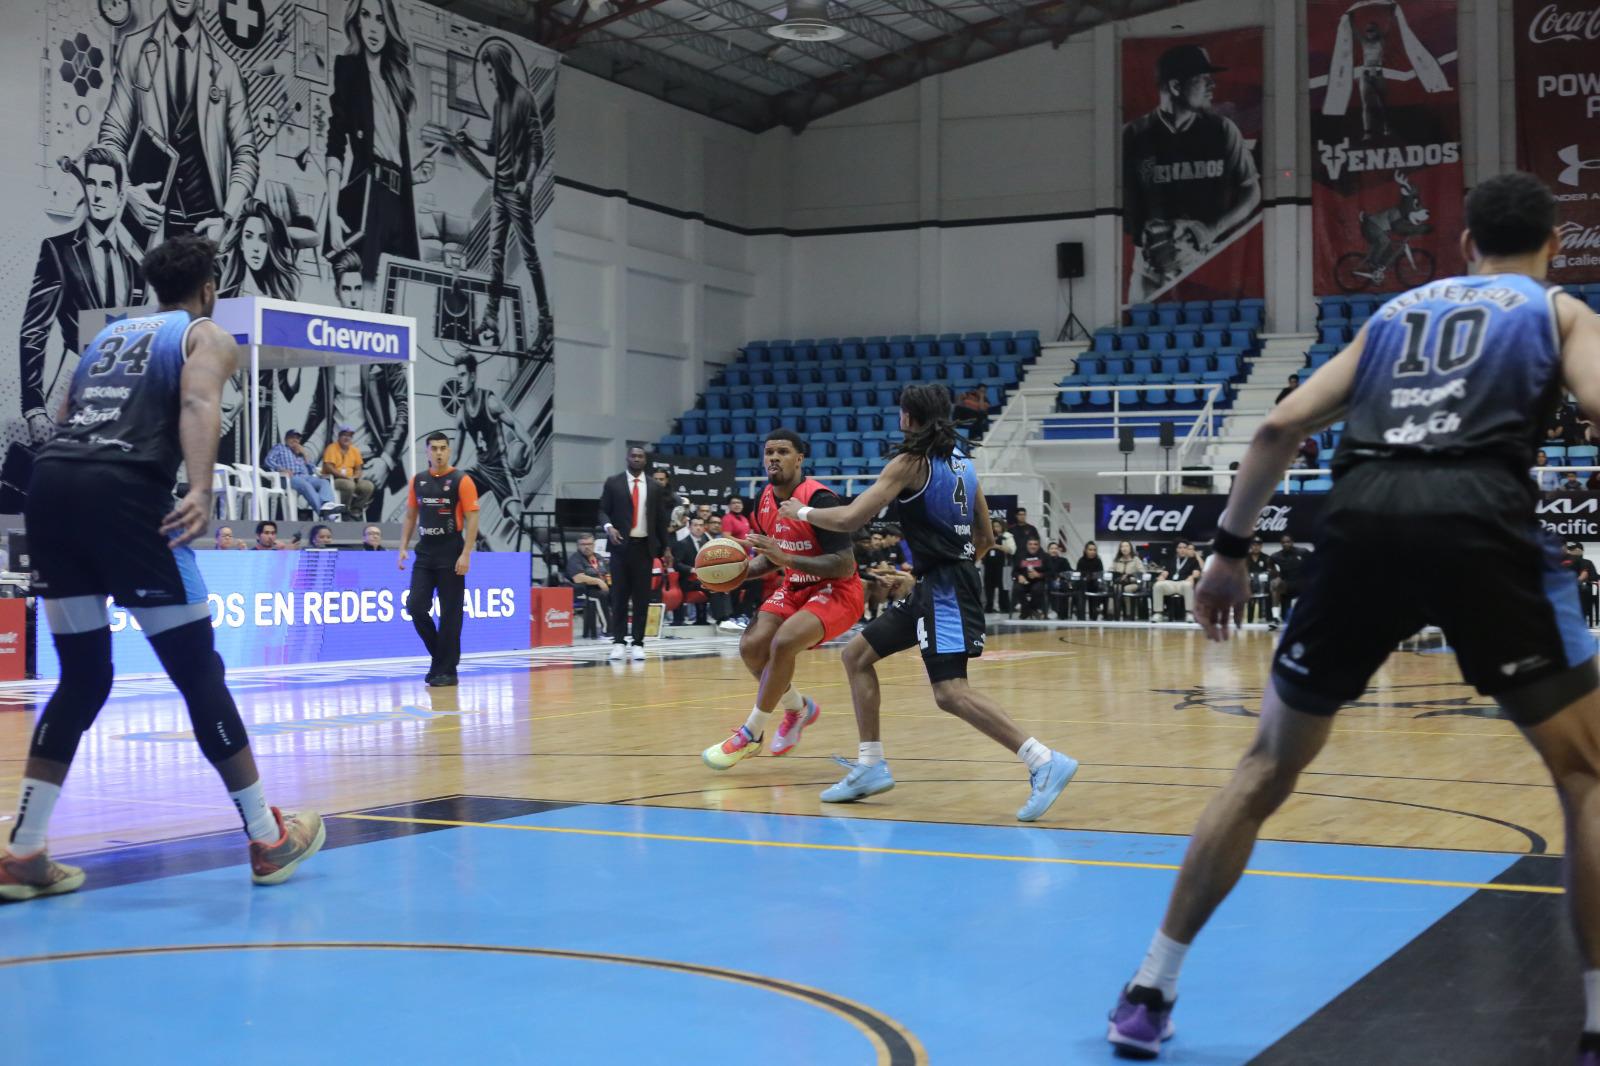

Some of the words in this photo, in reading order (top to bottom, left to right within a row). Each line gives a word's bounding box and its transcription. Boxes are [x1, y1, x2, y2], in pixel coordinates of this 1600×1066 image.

[1318, 137, 1460, 180] VENADOS
[89, 331, 156, 378] 34
[307, 319, 399, 354] Chevron
[1393, 305, 1490, 378] 10
[953, 476, 968, 517] 4
[1535, 499, 1598, 514] KIA
[1107, 505, 1194, 532] telcel
[254, 592, 295, 626] EN
[303, 589, 394, 625] REDES
[400, 587, 515, 623] SALES
